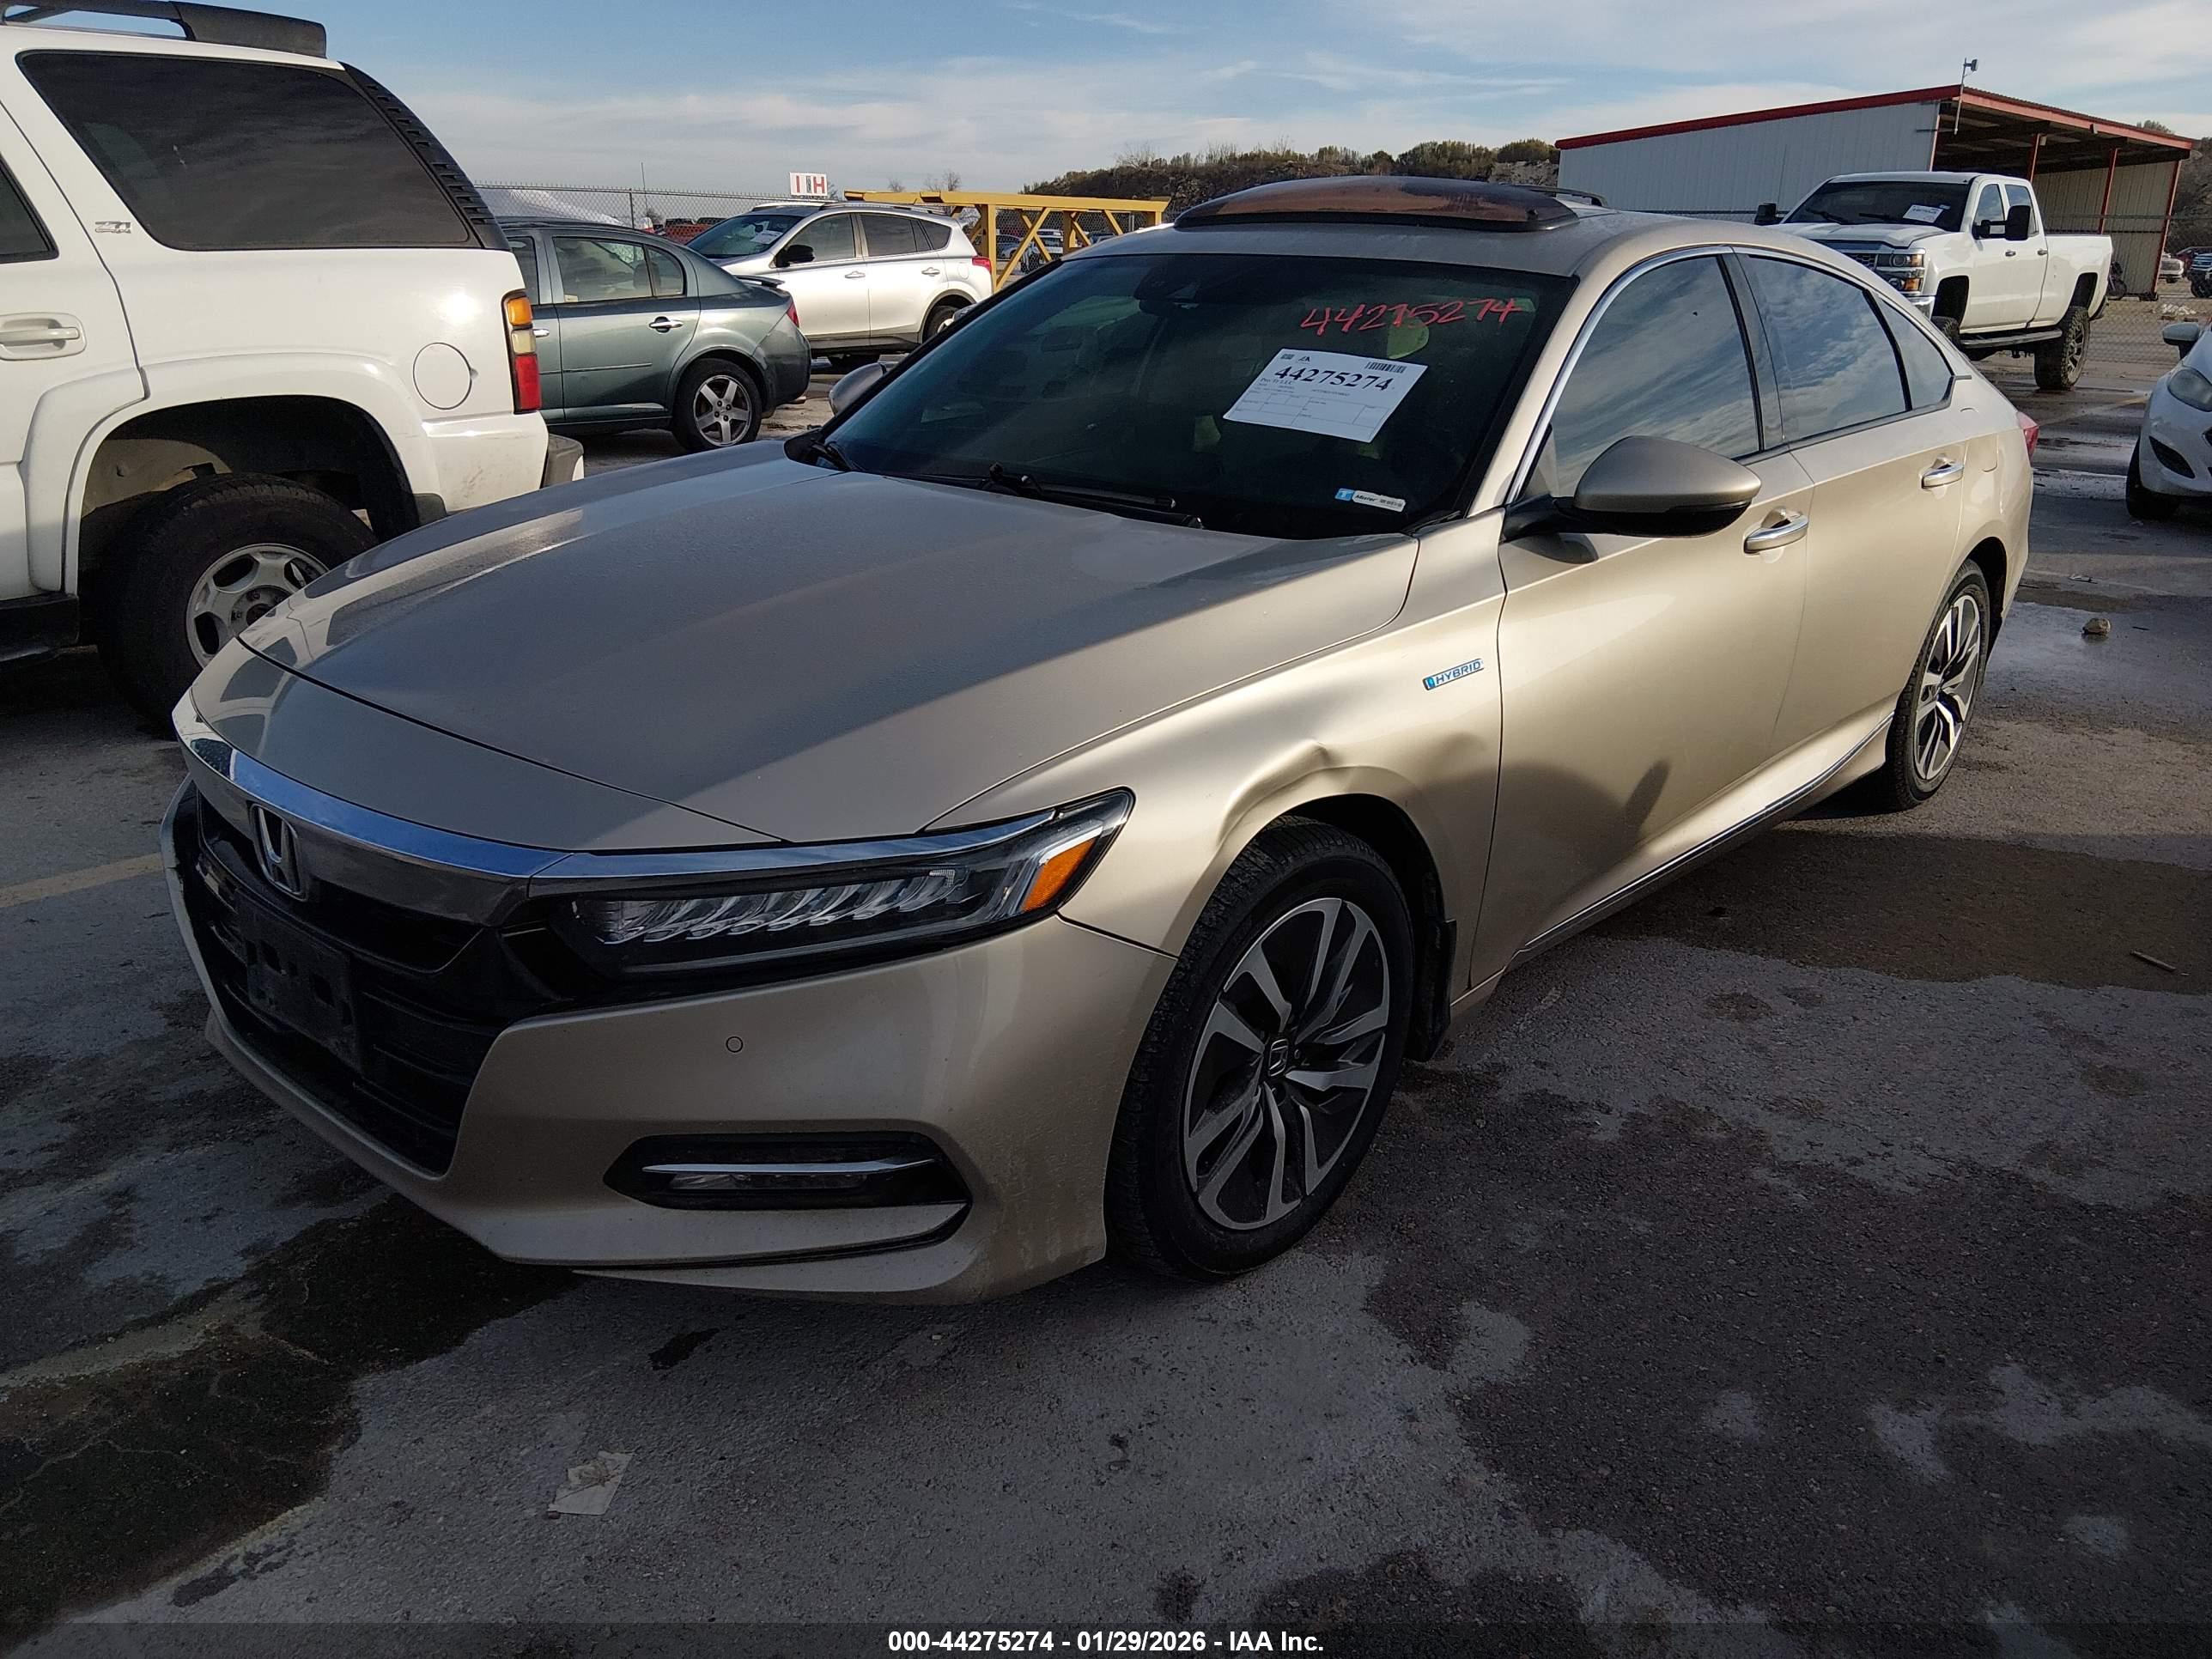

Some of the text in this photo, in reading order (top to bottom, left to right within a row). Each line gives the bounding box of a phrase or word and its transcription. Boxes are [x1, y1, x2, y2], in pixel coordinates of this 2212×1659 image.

[1300, 298, 1522, 336] 44275274
[1274, 366, 1395, 391] 44275274
[1436, 661, 1481, 684] HYBRID
